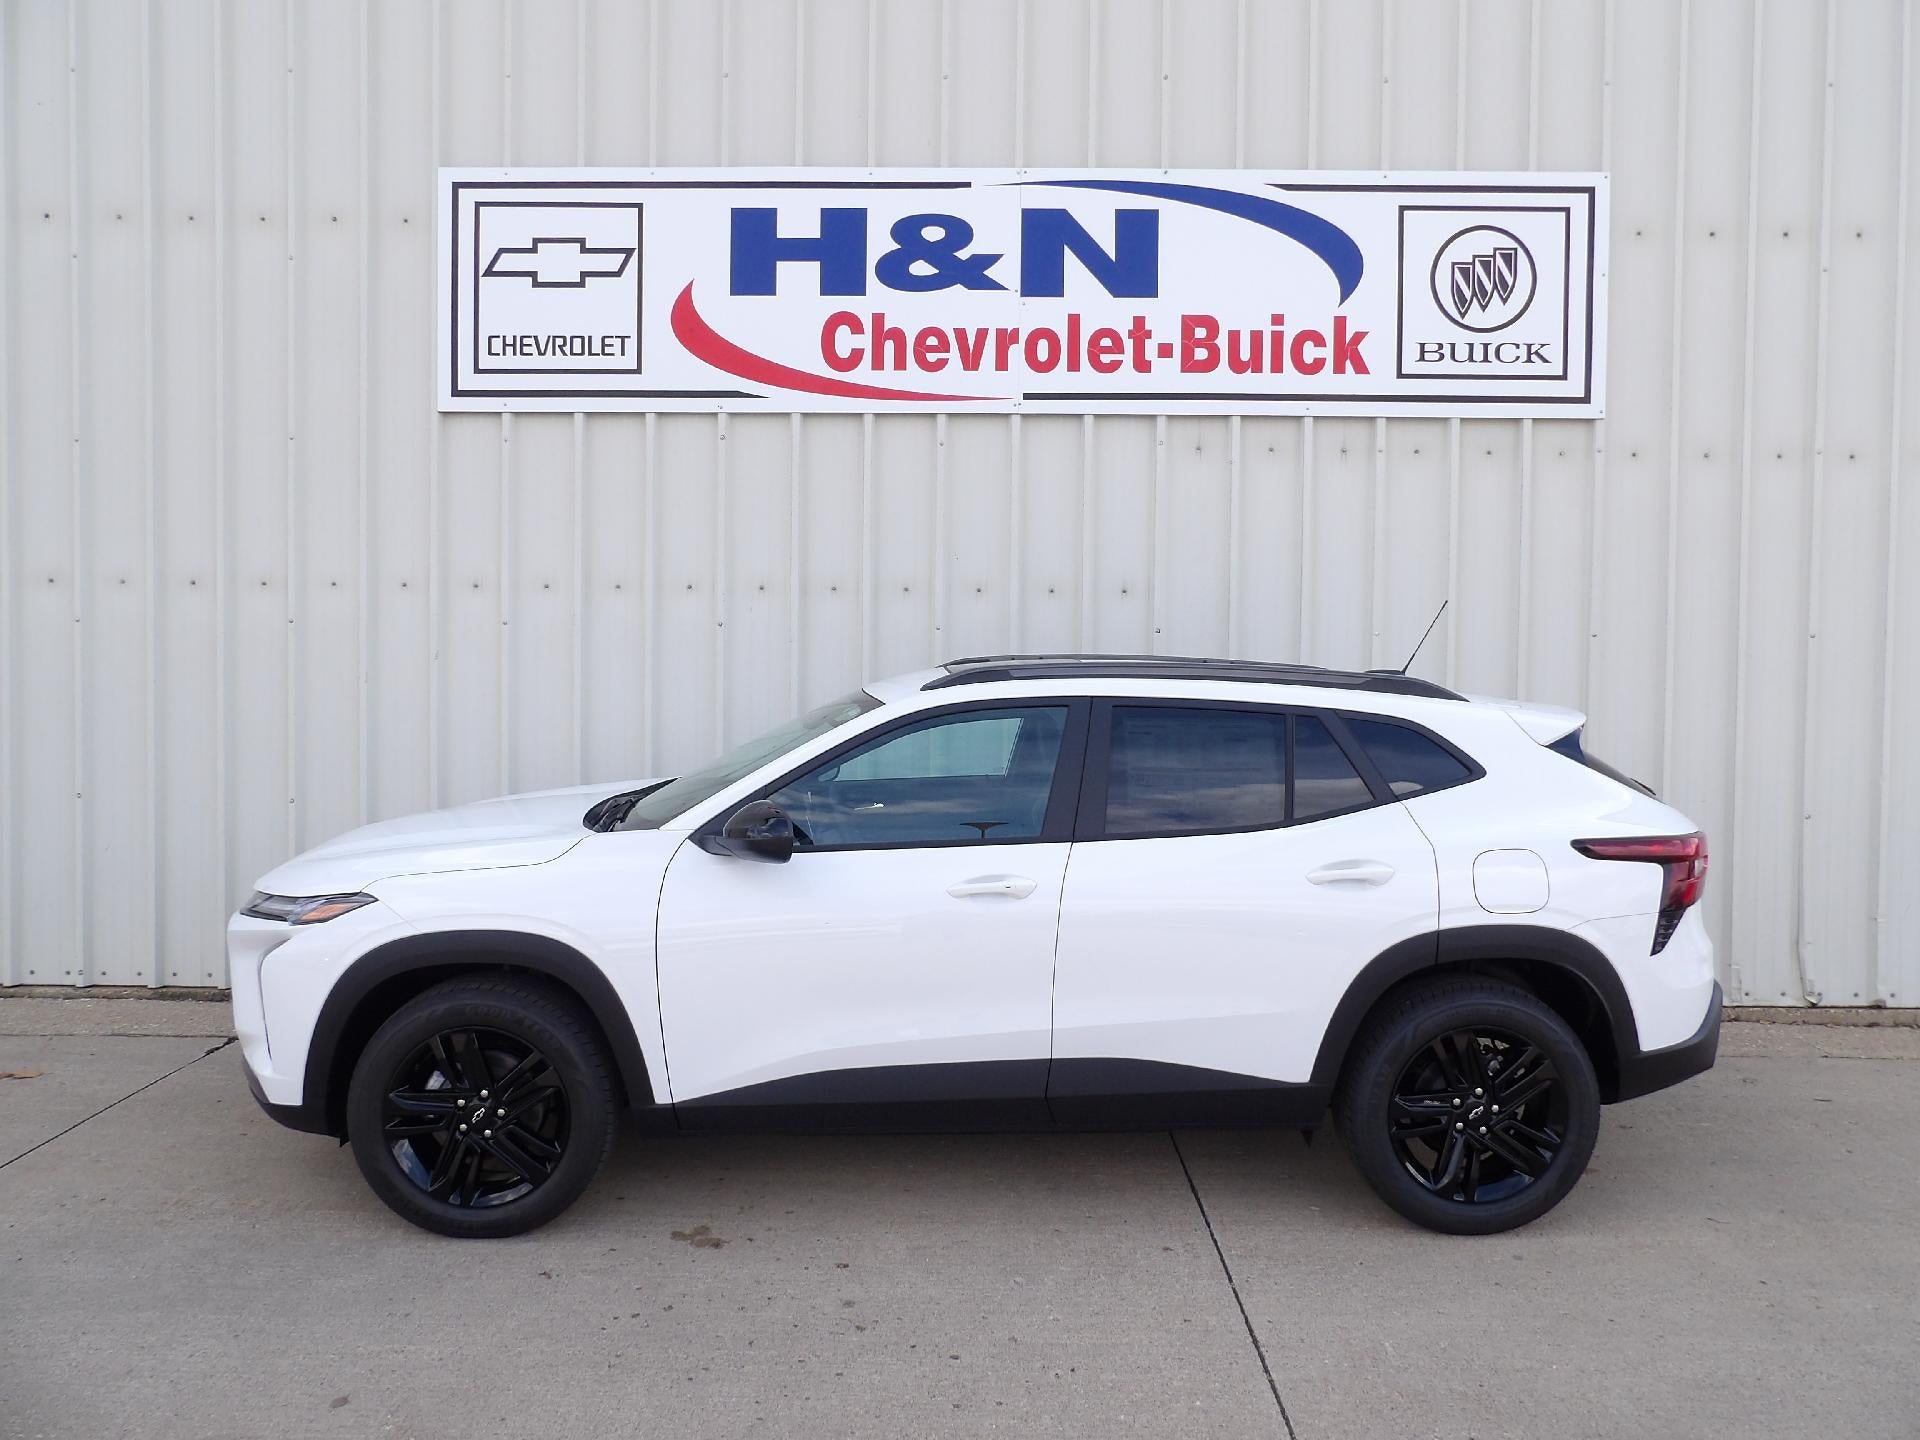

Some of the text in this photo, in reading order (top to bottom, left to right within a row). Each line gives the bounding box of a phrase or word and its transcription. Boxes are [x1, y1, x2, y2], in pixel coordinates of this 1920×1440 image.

[730, 207, 1158, 298] H&N
[487, 334, 632, 357] CHEVROLET
[821, 311, 1370, 376] Chevrolet-Buick
[1415, 342, 1552, 364] BUICK
